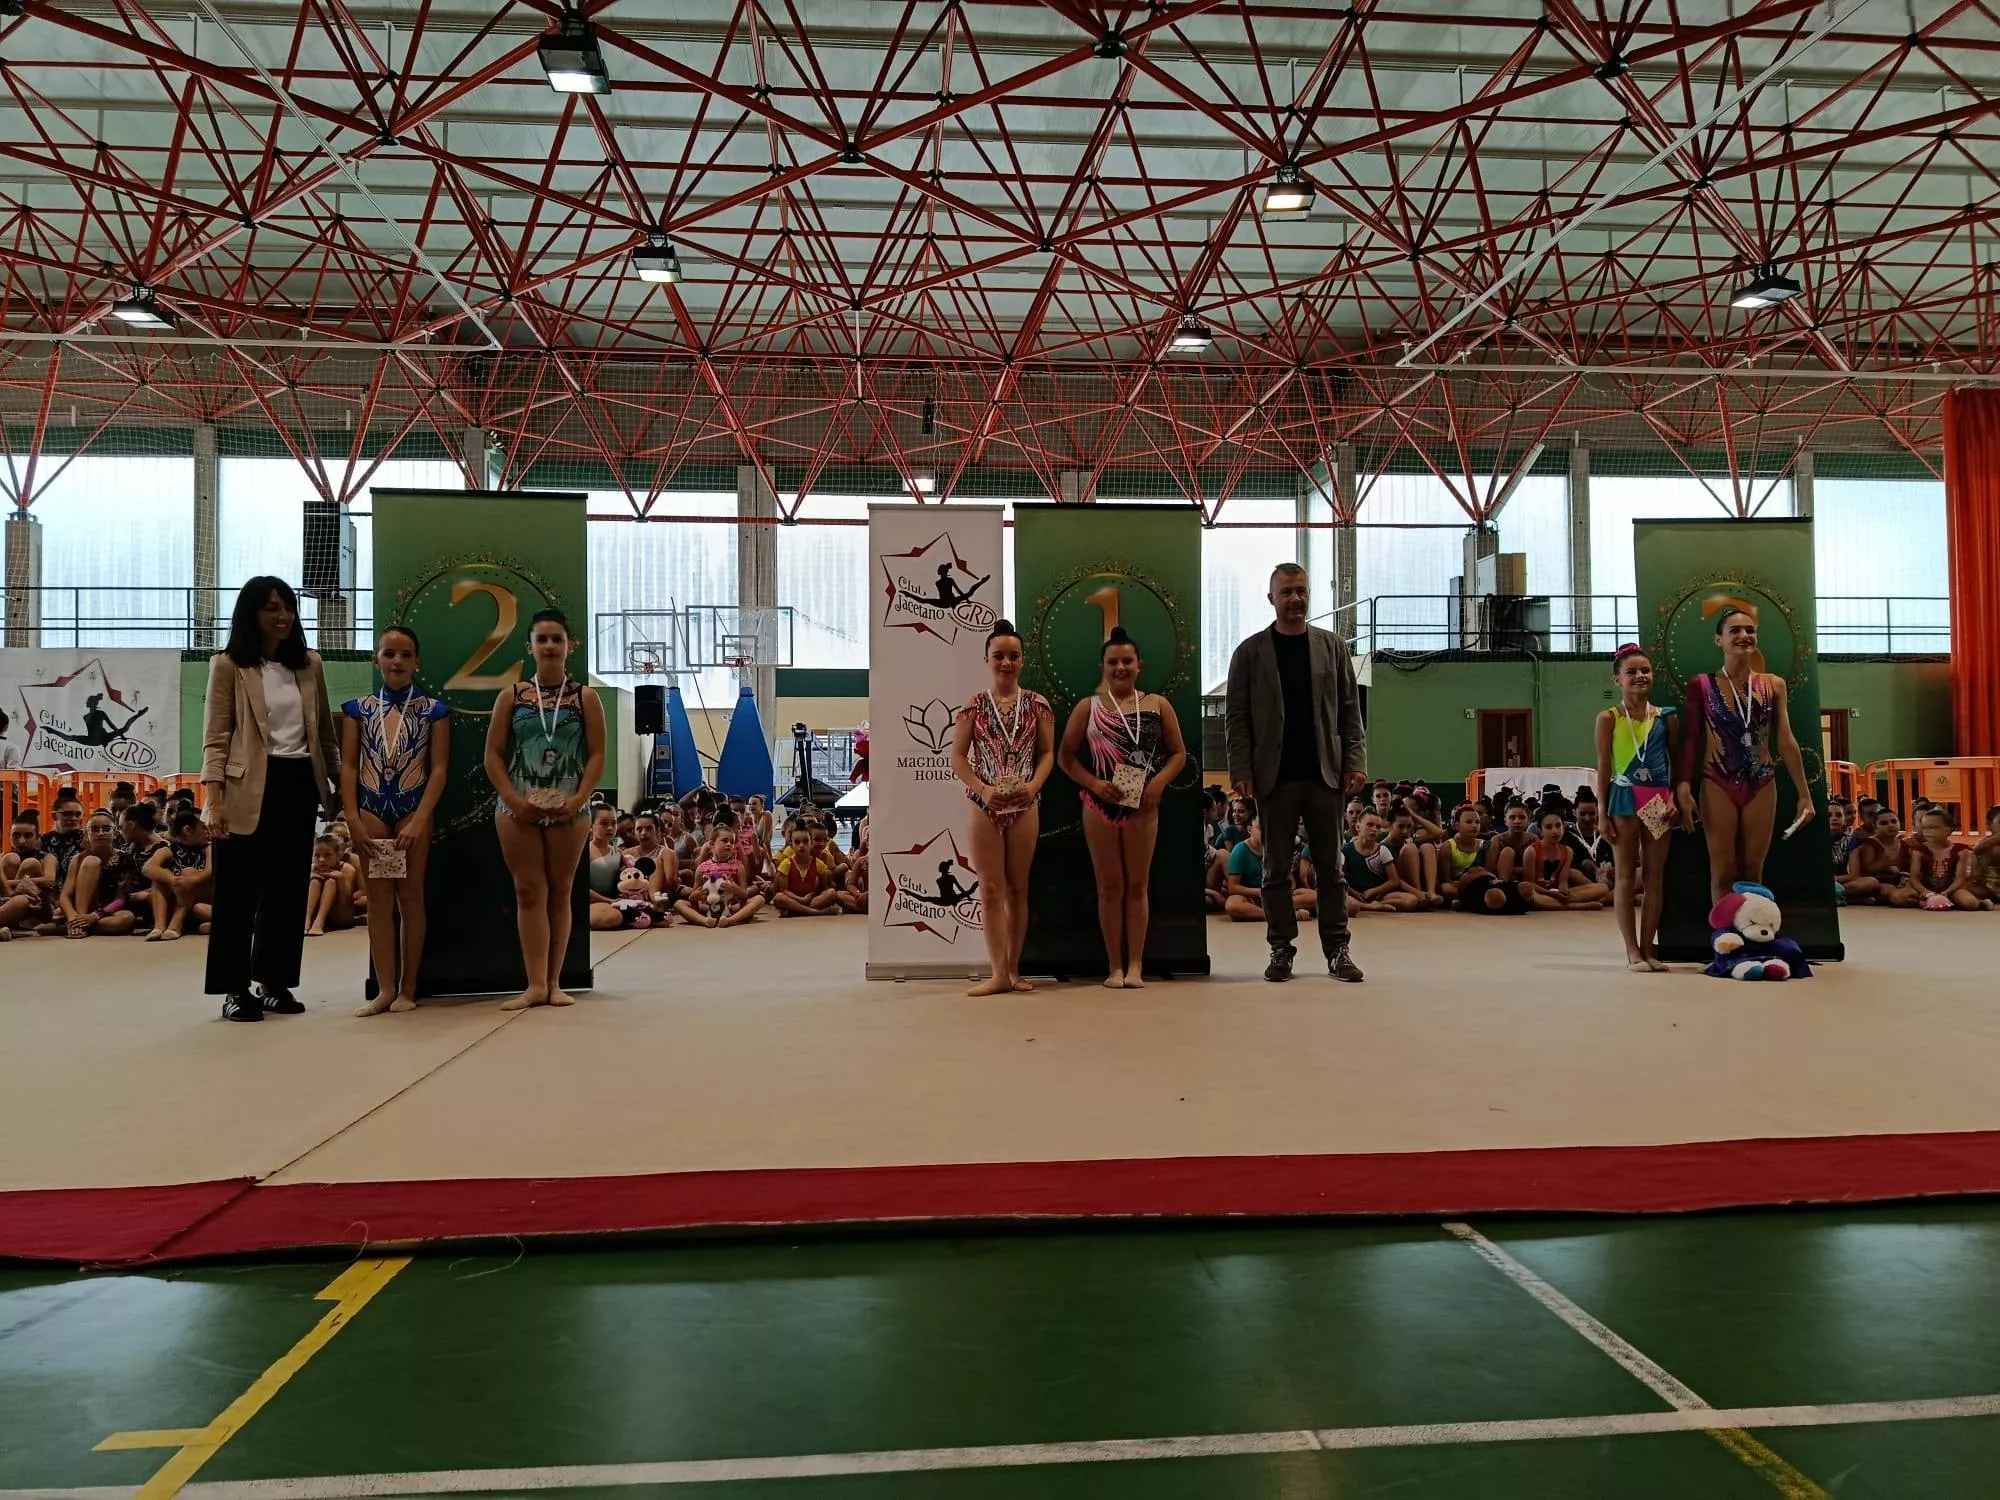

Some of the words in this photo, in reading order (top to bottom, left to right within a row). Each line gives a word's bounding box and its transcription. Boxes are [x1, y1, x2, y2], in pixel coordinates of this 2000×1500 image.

[898, 576, 927, 596] Club
[895, 595, 945, 620] Jacetano
[957, 604, 995, 626] GRD
[443, 580, 525, 691] 2
[40, 709, 73, 732] Club
[35, 731, 95, 761] Jacetano
[110, 742, 153, 765] GRD
[899, 874, 927, 895] Club
[895, 893, 946, 919] Jacetano
[958, 902, 982, 923] GR
